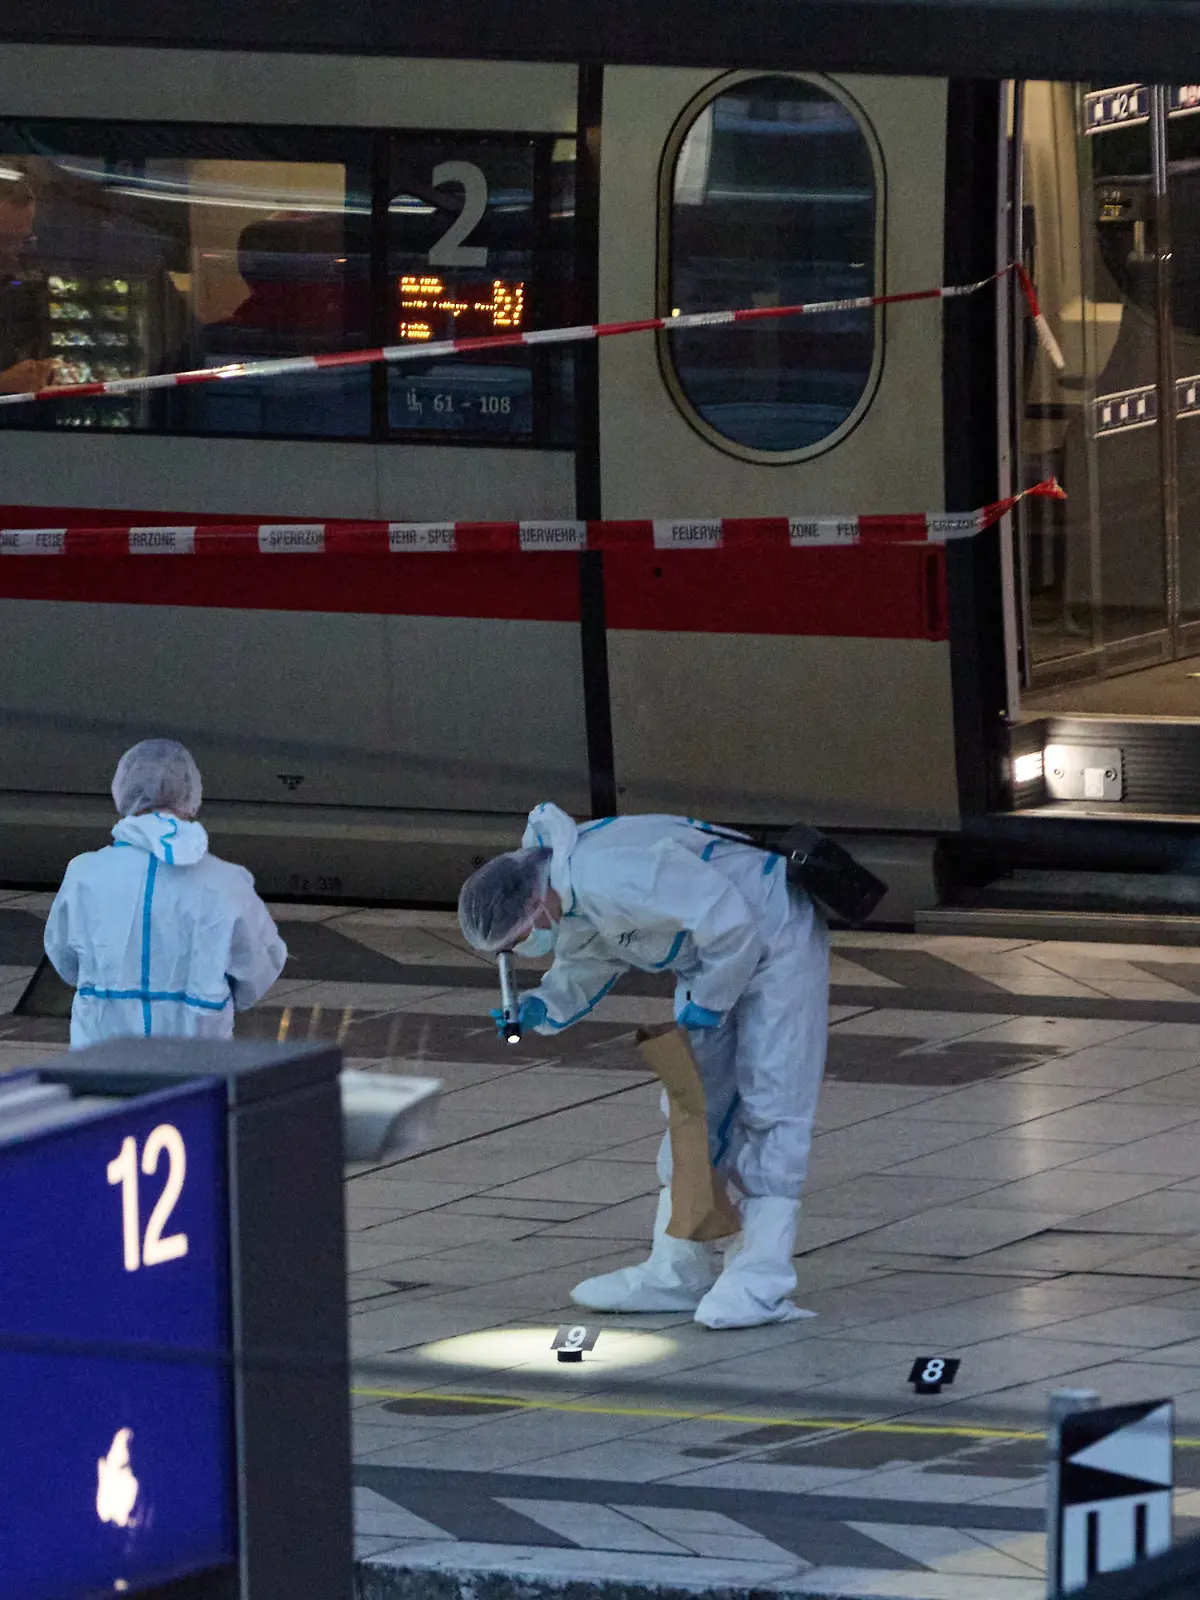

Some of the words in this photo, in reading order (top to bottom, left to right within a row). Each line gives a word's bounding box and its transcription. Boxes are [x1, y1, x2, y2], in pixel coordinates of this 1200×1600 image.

[428, 160, 489, 267] 2
[433, 393, 454, 415] 61
[479, 395, 511, 415] 108
[106, 1123, 189, 1273] 12
[567, 1326, 587, 1349] 9
[921, 1358, 945, 1382] 8
